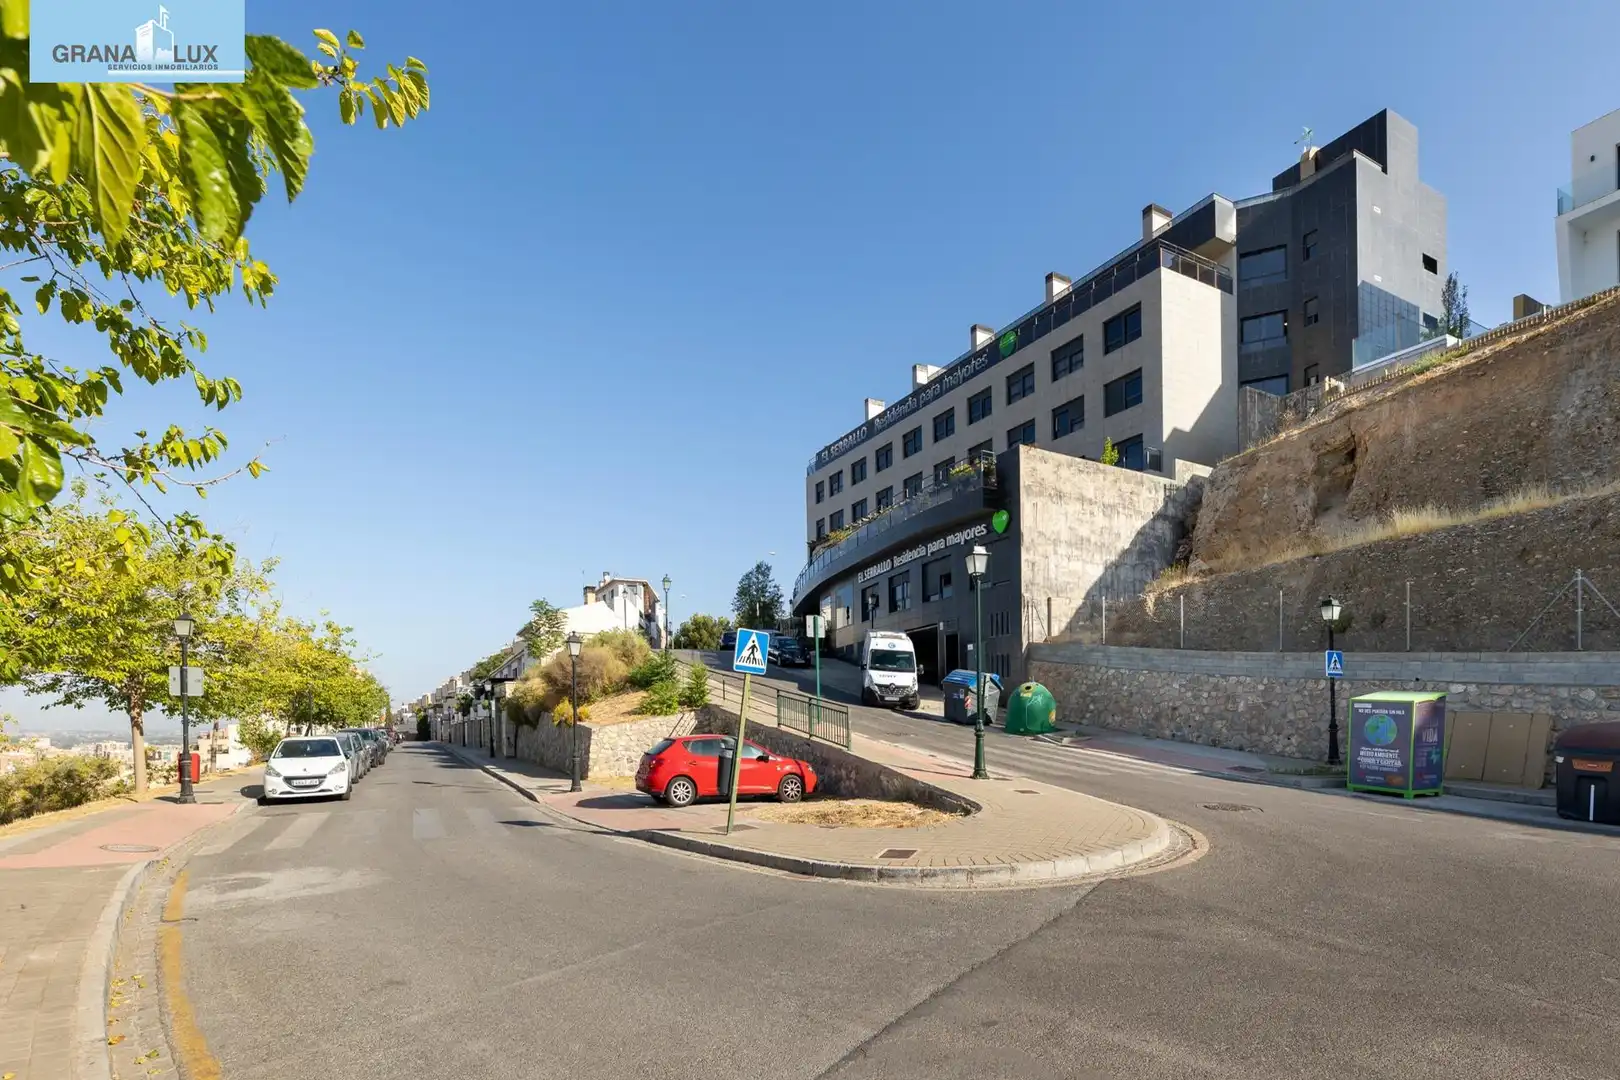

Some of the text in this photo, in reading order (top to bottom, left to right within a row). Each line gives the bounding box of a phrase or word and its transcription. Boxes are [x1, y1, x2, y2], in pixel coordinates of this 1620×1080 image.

[821, 449, 829, 461] EL
[919, 383, 941, 408] para
[943, 353, 988, 391] mayores
[857, 523, 988, 583] EL SERRALLO Residencia para mayores
